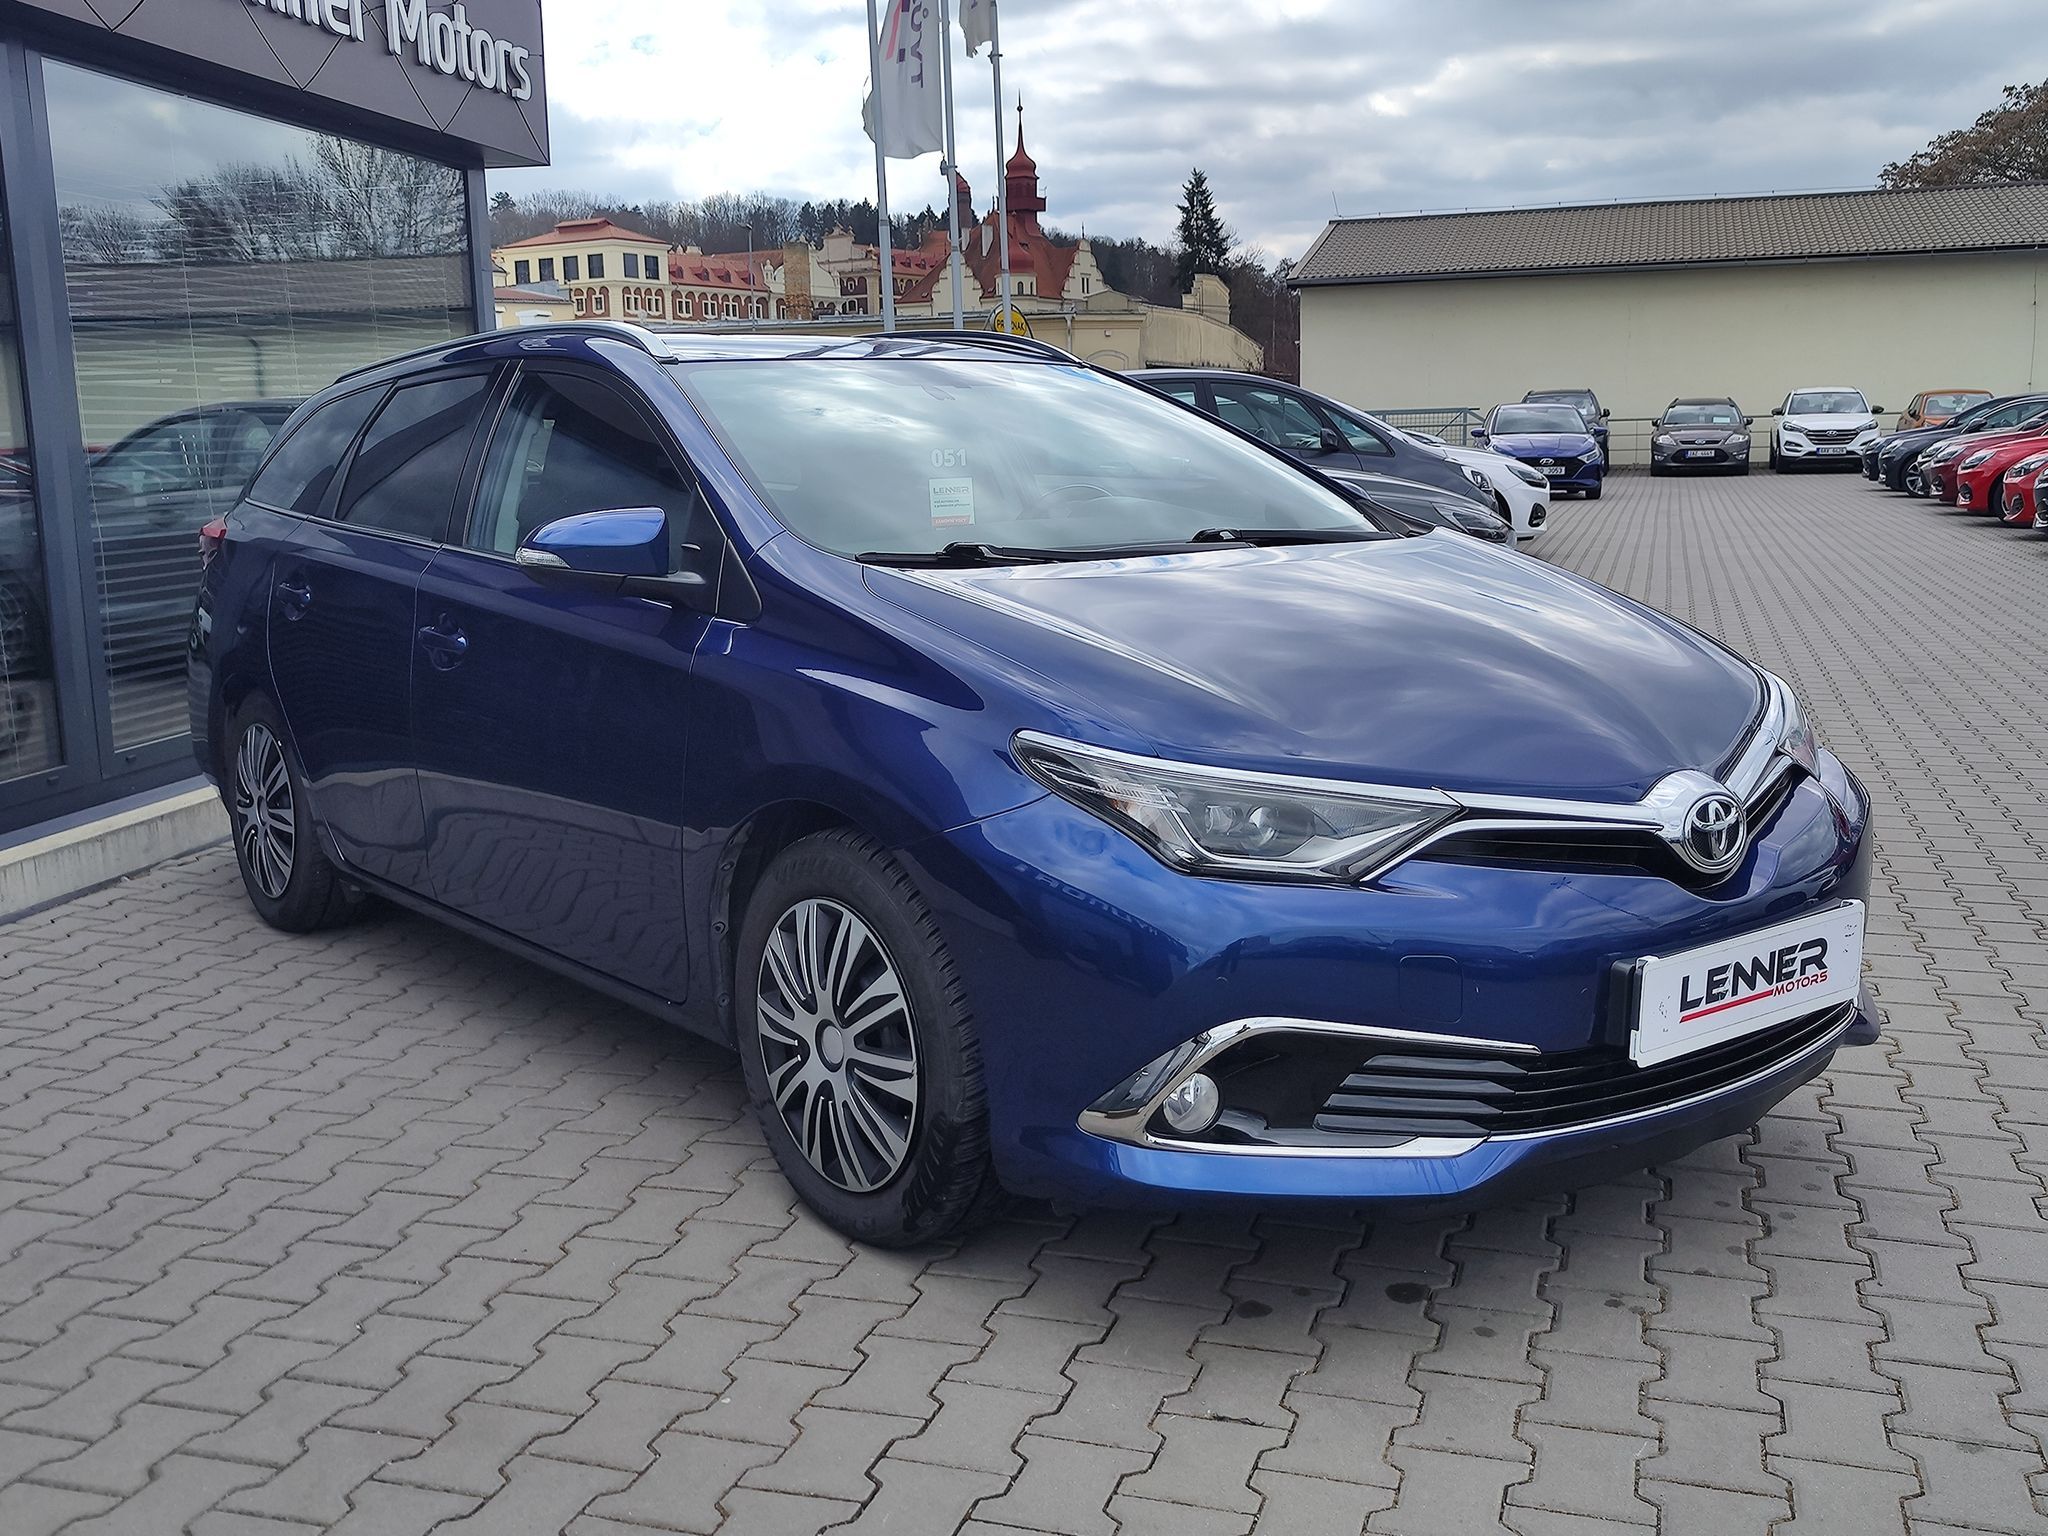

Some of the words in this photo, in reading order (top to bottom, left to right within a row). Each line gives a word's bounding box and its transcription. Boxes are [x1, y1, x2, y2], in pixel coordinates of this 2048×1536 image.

[384, 0, 533, 101] Motors
[931, 448, 967, 467] 051
[1679, 937, 1829, 1013] LENNER
[1773, 970, 1829, 997] MOTORS
